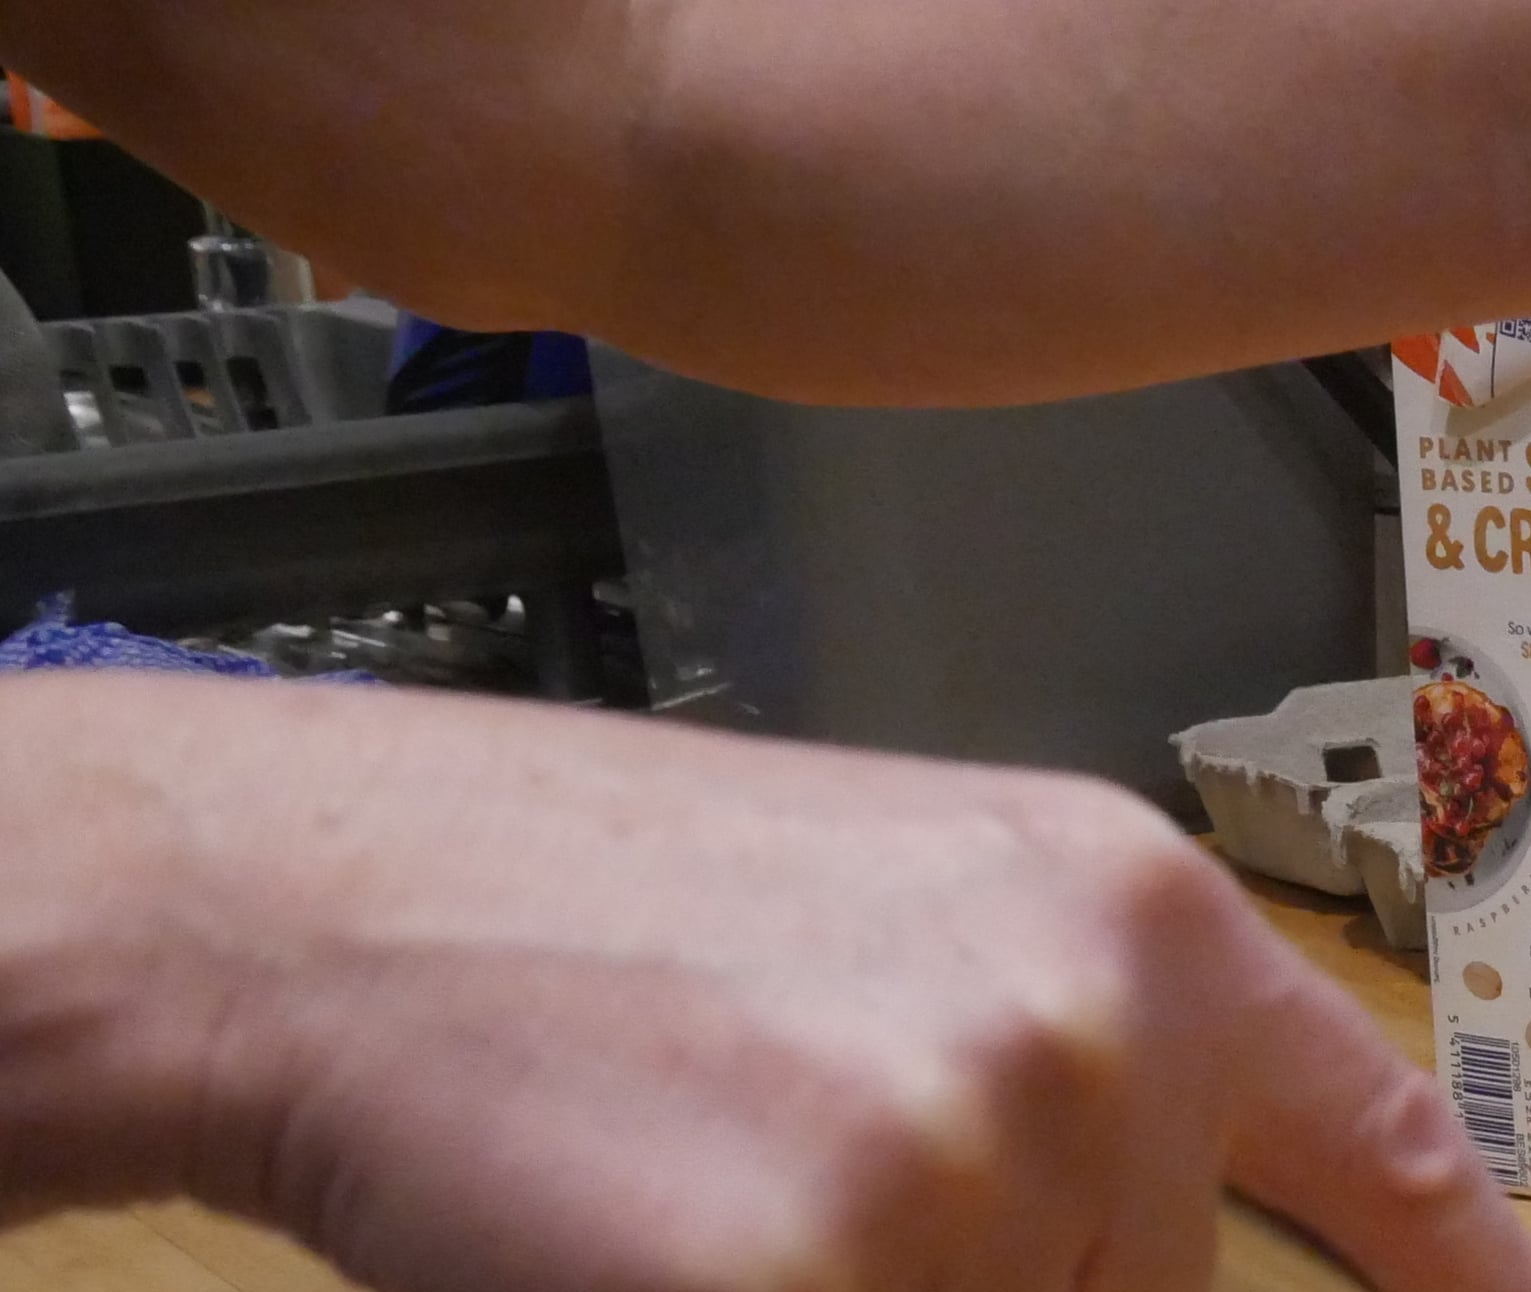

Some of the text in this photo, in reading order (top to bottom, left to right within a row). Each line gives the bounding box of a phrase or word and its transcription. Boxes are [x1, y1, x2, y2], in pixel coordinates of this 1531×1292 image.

[1419, 436, 1513, 463] PLANT
[1421, 468, 1515, 495] BASED
[1425, 502, 1466, 571] &
[1508, 621, 1524, 636] So
[1447, 1015, 1459, 1024] 5
